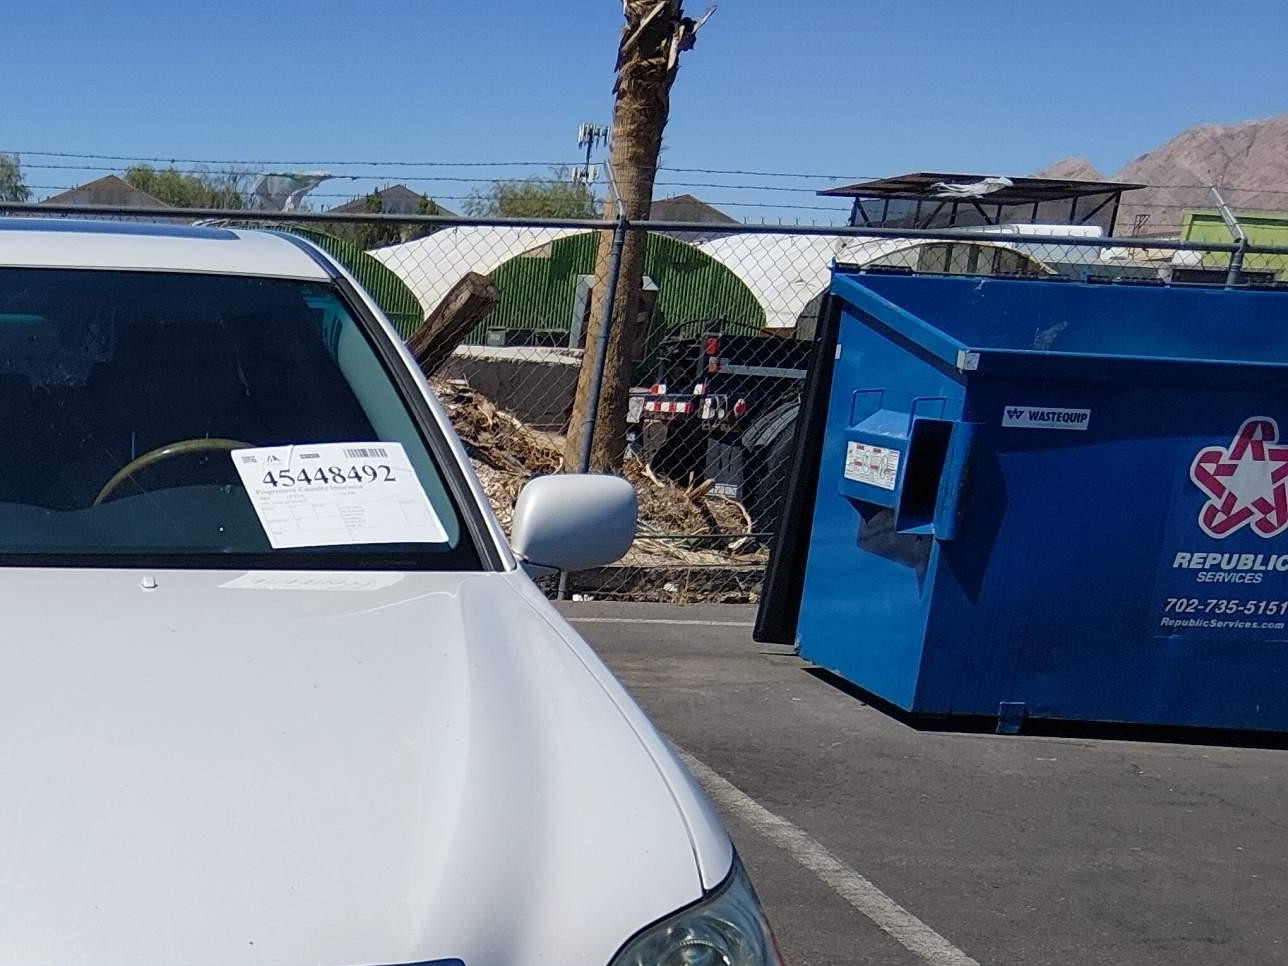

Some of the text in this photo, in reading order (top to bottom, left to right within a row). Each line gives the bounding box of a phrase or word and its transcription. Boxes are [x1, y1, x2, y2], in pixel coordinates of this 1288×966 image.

[1028, 410, 1088, 424] WASTEQUIP
[262, 465, 396, 487] 45448492
[1173, 553, 1288, 571] REPUBLIC
[1196, 571, 1263, 584] SERVICES
[1164, 599, 1287, 615] 702-735-5151
[1161, 617, 1285, 629] RepublicServices.com
